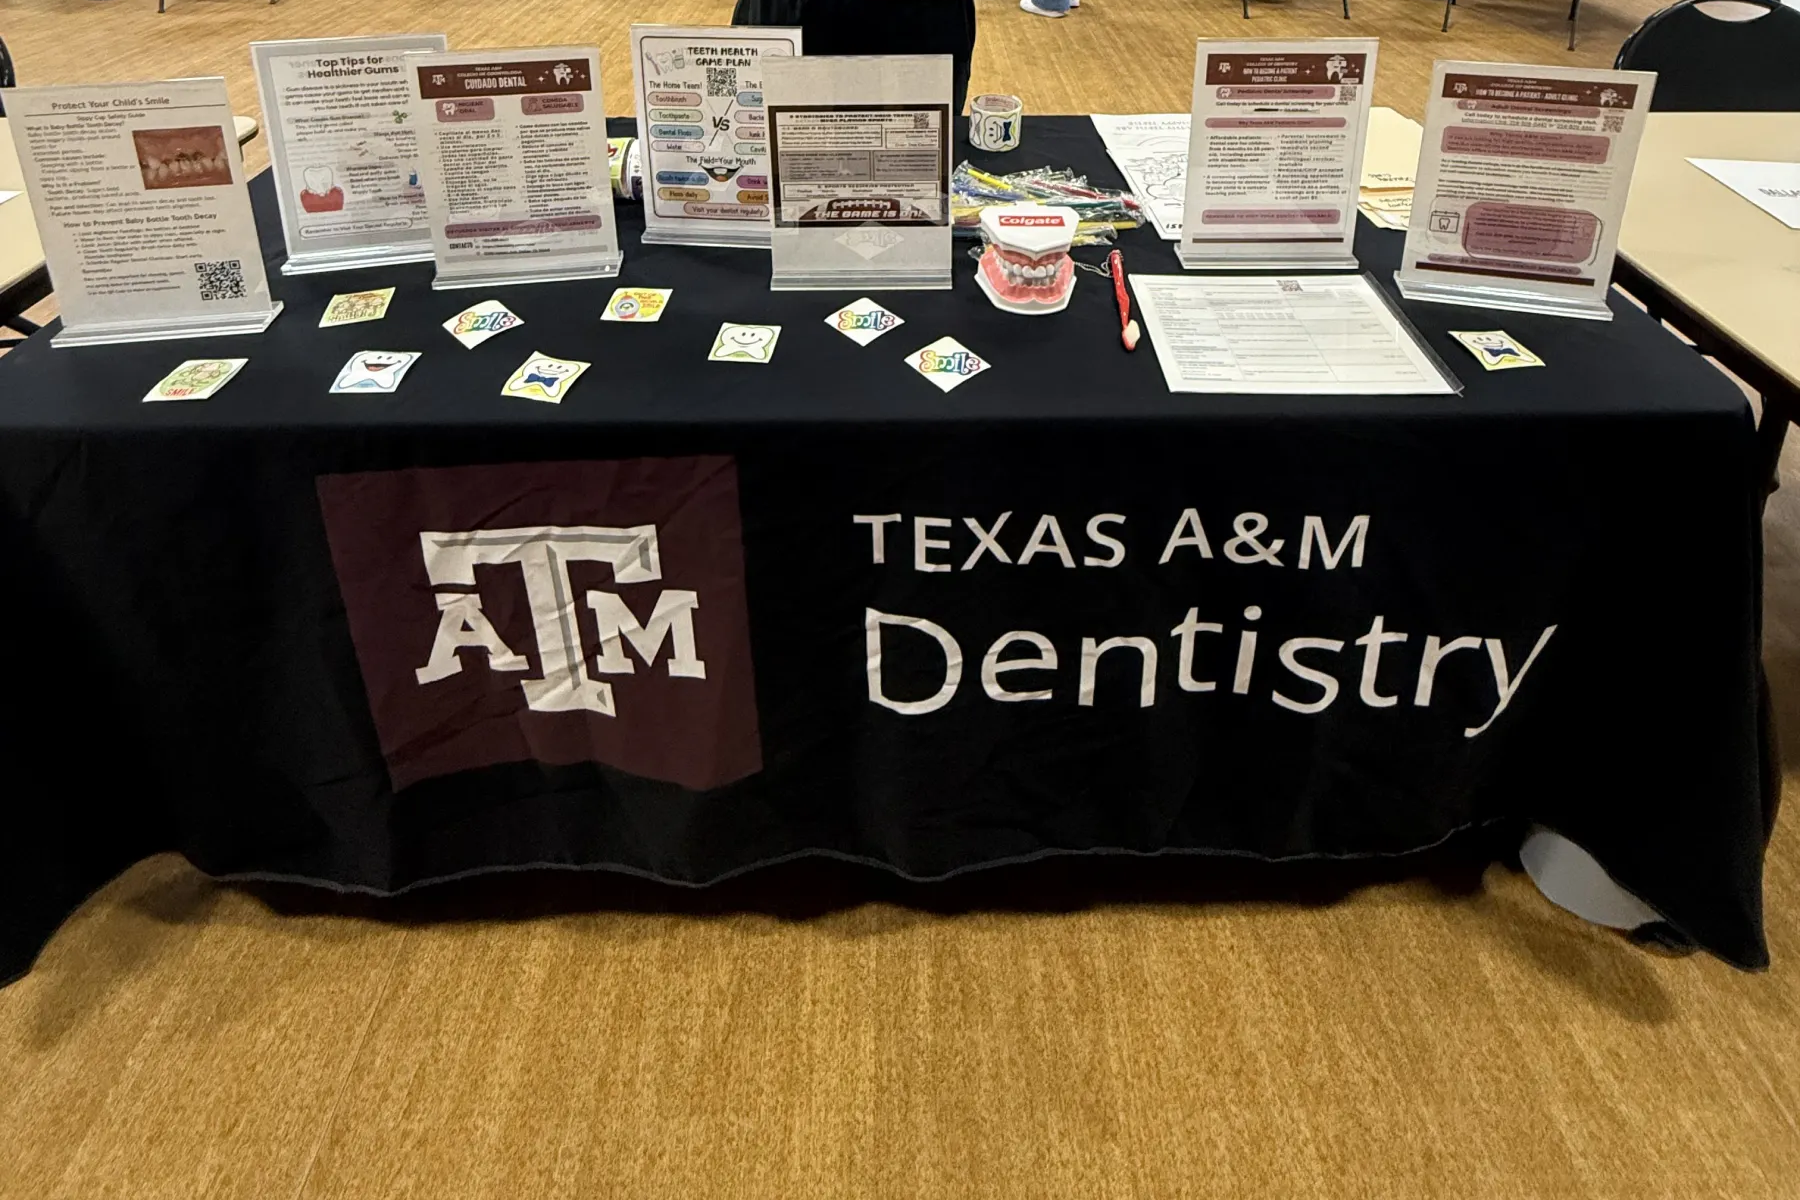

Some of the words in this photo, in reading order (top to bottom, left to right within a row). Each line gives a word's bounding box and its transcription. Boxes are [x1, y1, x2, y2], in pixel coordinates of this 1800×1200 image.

[687, 47, 718, 55] TEETH
[720, 48, 758, 56] HEALTH
[316, 58, 338, 70] Top
[340, 57, 365, 68] Tips
[366, 56, 384, 65] for
[696, 58, 723, 66] GAME
[725, 59, 752, 67] PLAN
[307, 67, 362, 79] Healthier
[364, 66, 399, 75] Gums
[464, 78, 498, 90] CUIDADO
[498, 76, 528, 88] DENTAL
[649, 80, 662, 88] The
[663, 82, 681, 90] Home
[682, 82, 702, 90] Team!
[745, 80, 757, 88] The
[52, 102, 86, 110] Protect
[88, 101, 109, 109] Your
[112, 98, 144, 106] Child's
[145, 96, 170, 106] Smile
[656, 95, 686, 103] Toothbrush
[94, 114, 106, 122] Cup
[658, 112, 690, 121] Toothpaste
[1476, 112, 1493, 120] today
[712, 116, 731, 132] VS
[686, 156, 698, 164] The
[735, 157, 756, 166] Mouth
[740, 208, 764, 216] regularly
[814, 210, 839, 218] THE
[842, 210, 880, 218] GAME
[882, 210, 897, 218] IS
[63, 221, 81, 229] How
[93, 218, 124, 227] Prevent
[126, 217, 144, 226] Baby
[146, 216, 169, 224] Bottle
[171, 214, 192, 222] Tooth
[194, 213, 217, 222] Decay
[1000, 216, 1062, 226] Colgate
[453, 311, 516, 336] Smile
[837, 310, 896, 332] Smile
[918, 350, 981, 376] Smile
[853, 511, 1125, 574] TEXAS
[1158, 507, 1370, 570] A&M
[865, 604, 1558, 738] Dentistry
